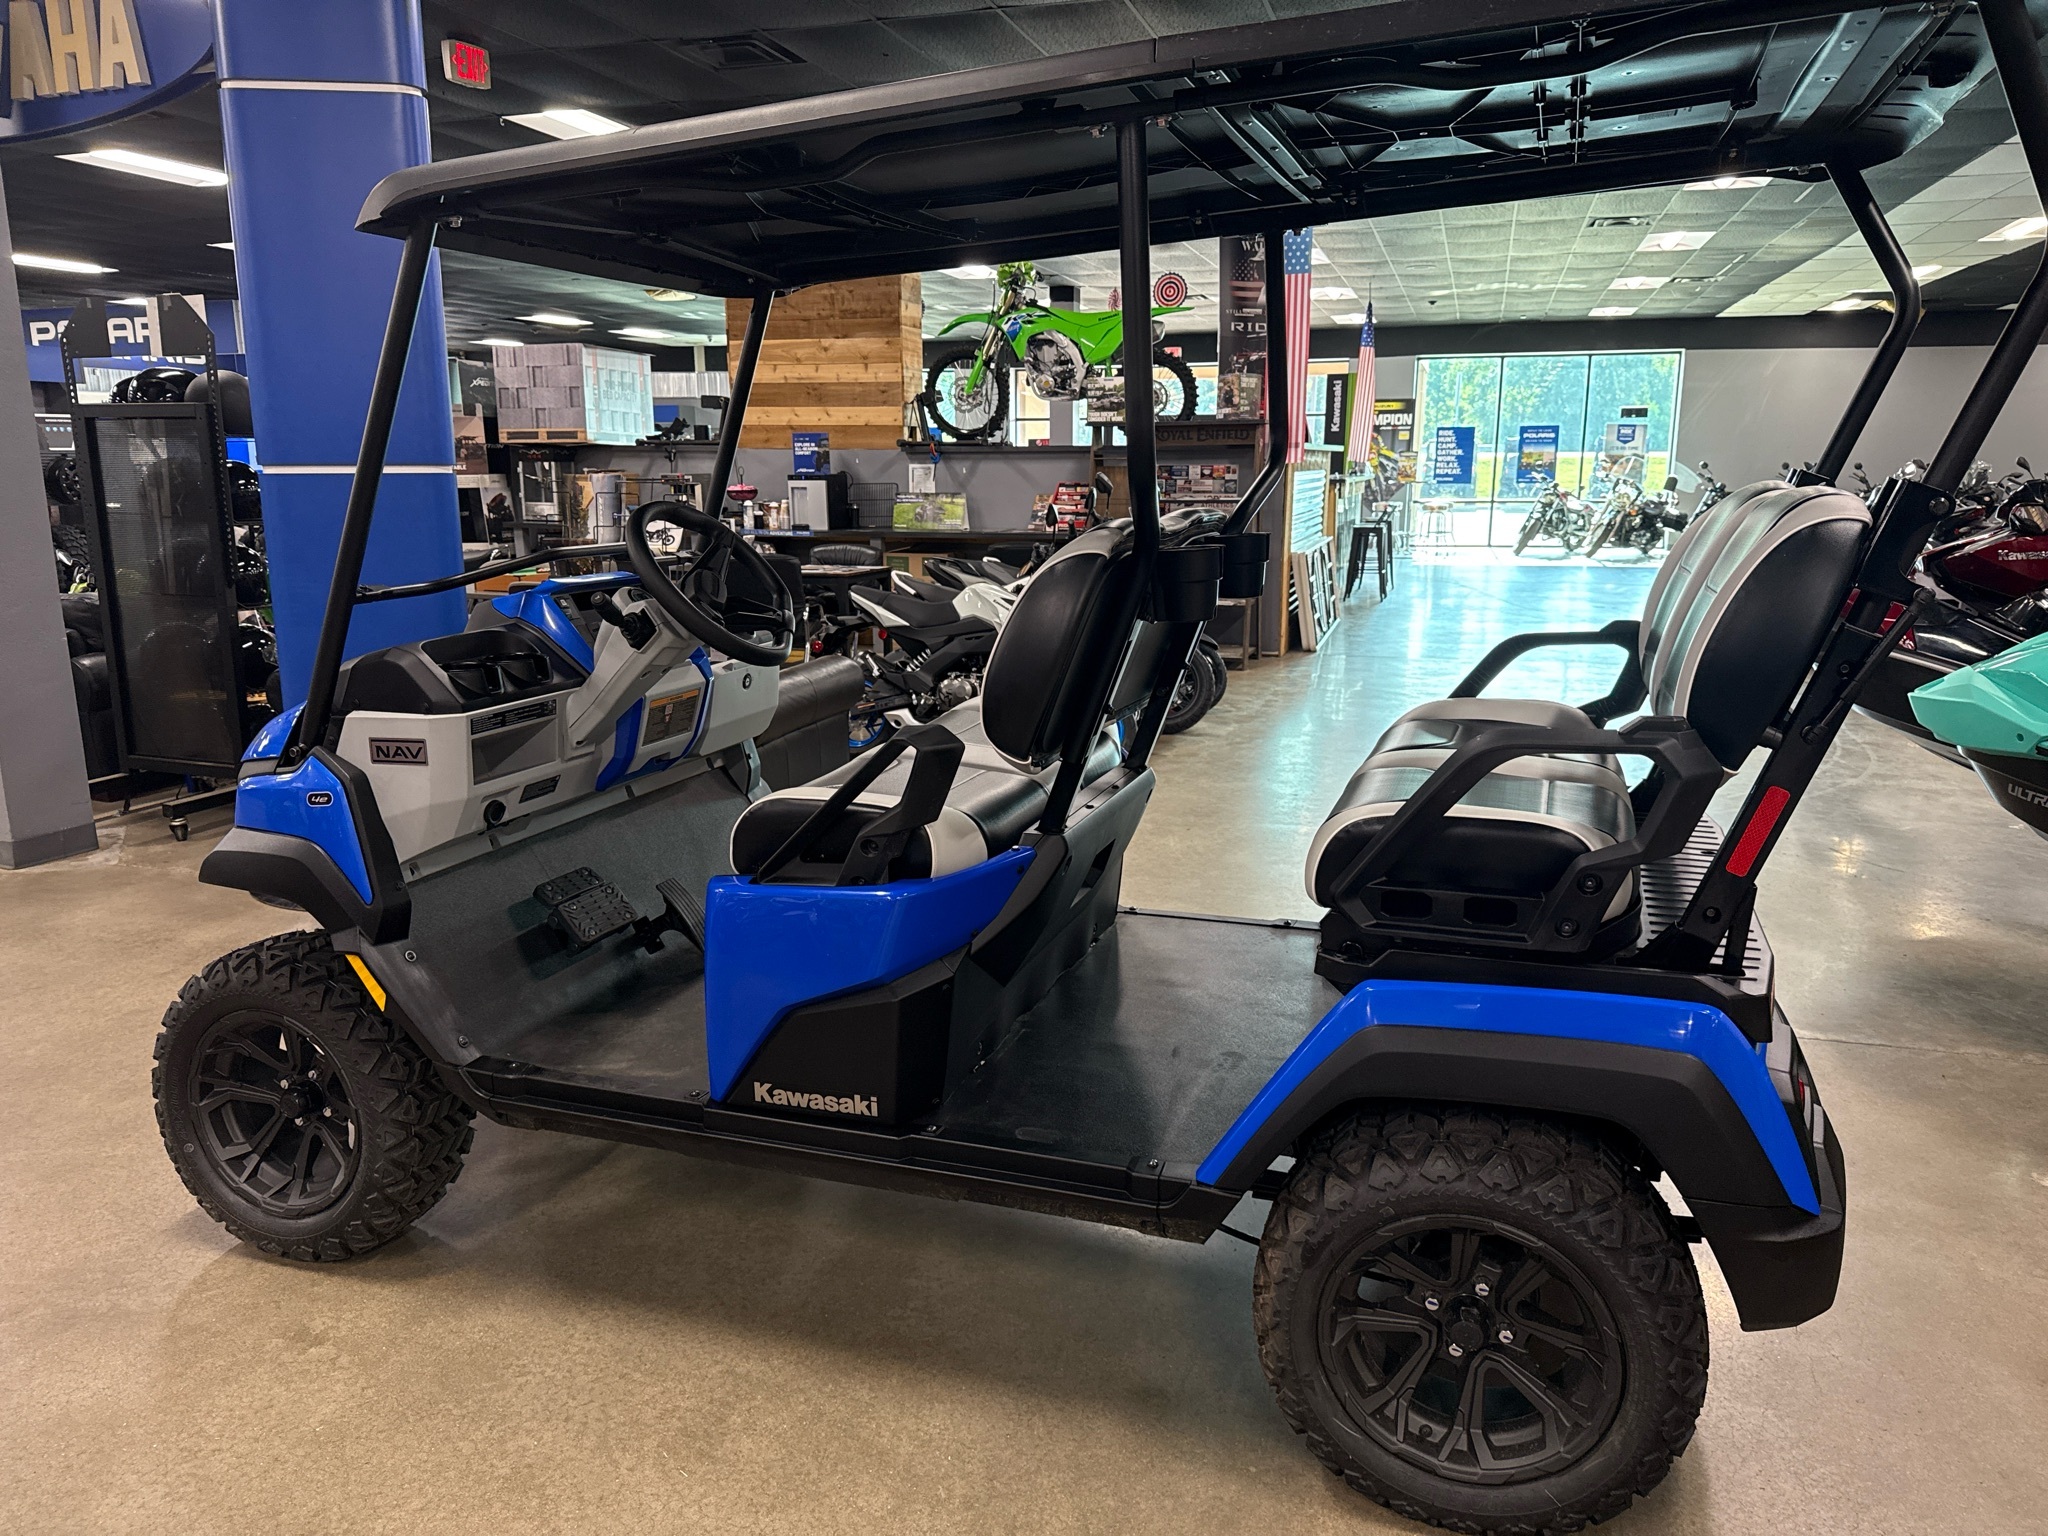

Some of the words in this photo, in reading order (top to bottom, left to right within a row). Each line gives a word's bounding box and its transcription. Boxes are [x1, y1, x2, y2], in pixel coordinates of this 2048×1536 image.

[0, 0, 151, 101] AHA
[455, 42, 486, 84] EXIT
[1330, 380, 1343, 432] Kawasaki
[1196, 427, 1250, 442] ENFIELD
[375, 745, 423, 760] NAV
[753, 1081, 879, 1117] Kawasaki
